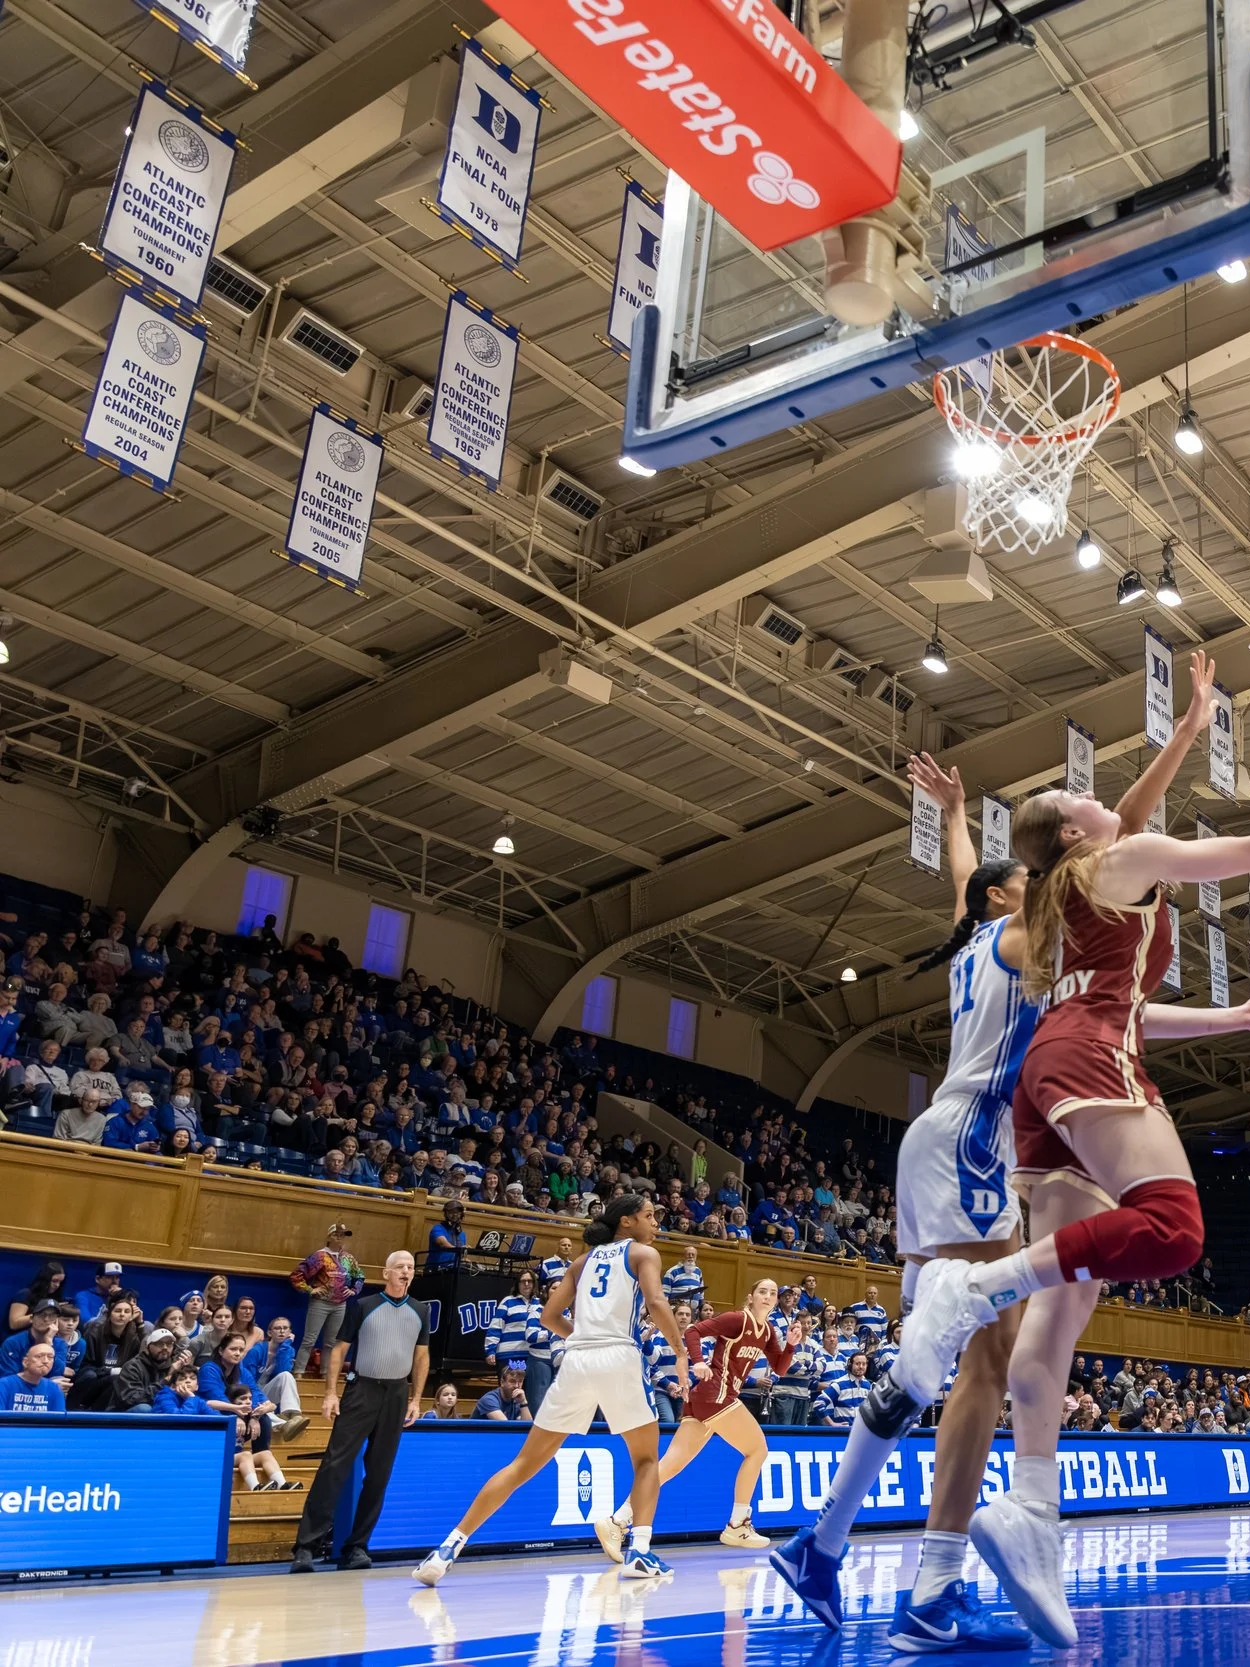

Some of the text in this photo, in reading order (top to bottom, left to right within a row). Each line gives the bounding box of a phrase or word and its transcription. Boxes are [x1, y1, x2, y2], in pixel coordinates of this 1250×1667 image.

[476, 145, 507, 180] NCAA
[143, 161, 206, 208] ATLANTIC
[452, 151, 521, 215] FINAL FOUR
[123, 182, 211, 245] CONFERENCE
[150, 182, 193, 217] COAST
[123, 200, 203, 258] CHAMPIONS
[469, 202, 499, 233] 1978
[133, 226, 186, 263] TOURNAMENT
[137, 246, 174, 276] 1960
[618, 286, 644, 309] FINA
[638, 279, 656, 298] NC
[122, 359, 177, 397] ATLANTIC
[128, 377, 166, 405] COAST
[454, 362, 501, 398] ATLANTIC
[460, 380, 492, 406] COAST
[103, 380, 181, 430] CONFERENCE
[103, 396, 175, 441] CHAMPIONS
[441, 382, 505, 430] CONFERENCE
[442, 398, 502, 441] CHAMPIONS
[105, 414, 165, 451] REGULAR SEASON
[444, 412, 495, 447] REGULAR SEASON
[449, 423, 488, 451] TOURNAMENT
[114, 435, 148, 461] 2004
[454, 437, 482, 461] 1963
[315, 471, 363, 503] ATLANTIC
[320, 488, 353, 511] COAST
[301, 491, 368, 533] CONFERENCE
[302, 505, 362, 544] CHAMPIONS
[309, 525, 349, 550] TOURNAMENT
[312, 542, 341, 564] 2005
[1154, 691, 1168, 707] NCAA
[918, 800, 938, 816] ATLANTIC
[914, 816, 941, 836] CONFERENCE
[972, 1189, 1000, 1214] D
[589, 1263, 611, 1298] 3
[742, 1361, 751, 1377] 1
[758, 1450, 1168, 1513] DUE STBALL
[0, 1483, 120, 1514] eHealth
[19, 1570, 68, 1578] DAKTRONICS
